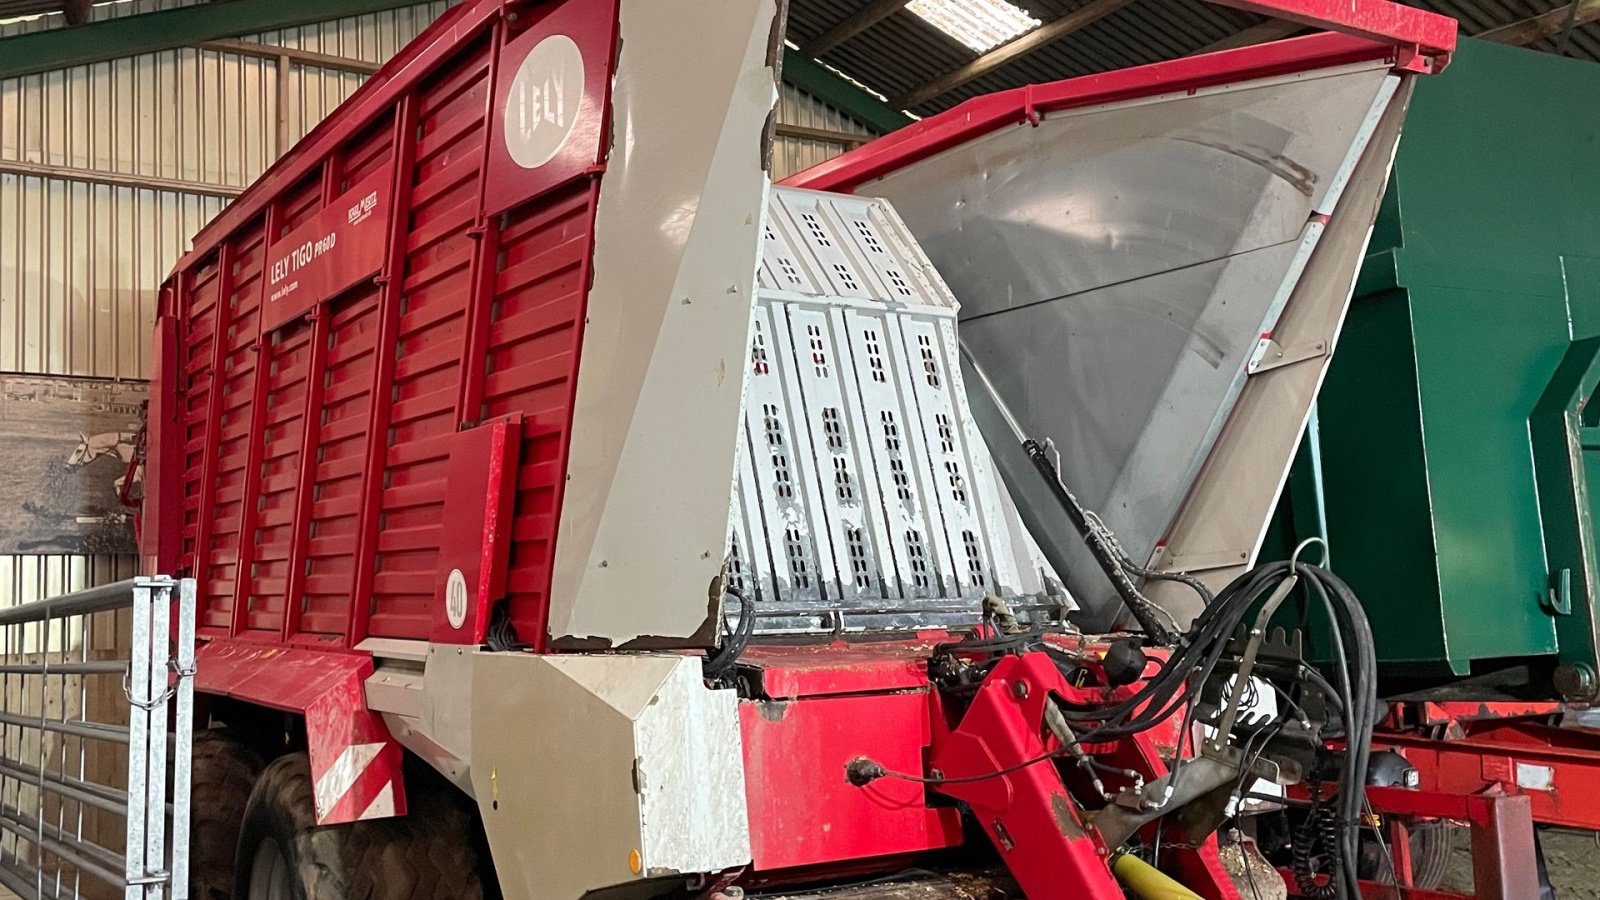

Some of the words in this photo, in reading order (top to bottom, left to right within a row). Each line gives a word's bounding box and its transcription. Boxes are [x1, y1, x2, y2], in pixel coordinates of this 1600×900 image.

[519, 65, 564, 143] LELY
[270, 254, 290, 285] LELY
[291, 240, 313, 272] TIGO
[314, 232, 336, 258] PR60D
[270, 280, 298, 302] www.lely.com
[450, 580, 463, 617] 40
